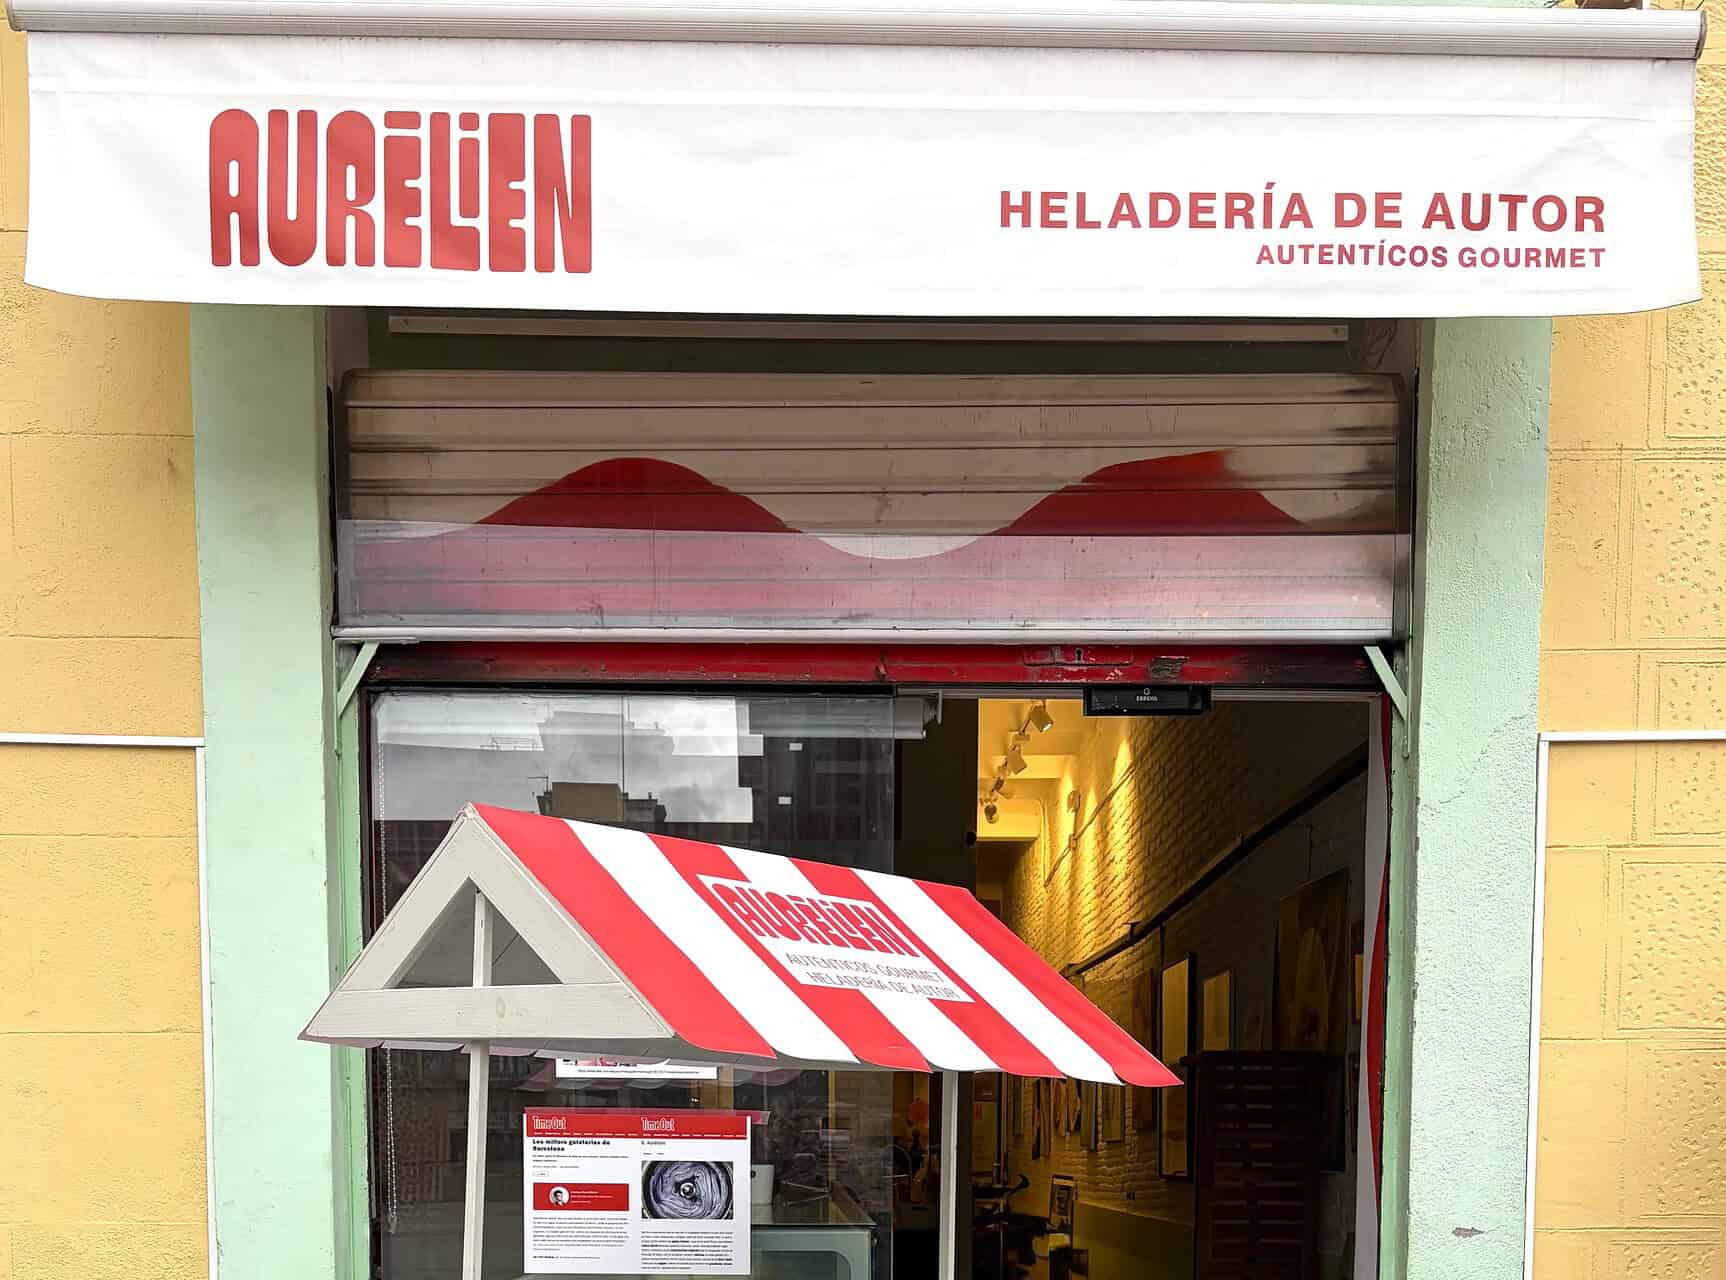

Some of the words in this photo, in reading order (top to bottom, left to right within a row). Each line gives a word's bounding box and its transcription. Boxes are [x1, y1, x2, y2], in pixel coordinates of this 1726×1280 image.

[1000, 182, 1314, 230] HELADERÍA
[1334, 191, 1403, 229] DE
[1422, 192, 1605, 233] AUTOR
[1256, 239, 1448, 268] AUTENTÍCOS
[1458, 246, 1606, 268] GOURMET
[876, 964, 945, 982] GOURMET
[888, 981, 914, 993] DE
[911, 983, 961, 999] AUTOR
